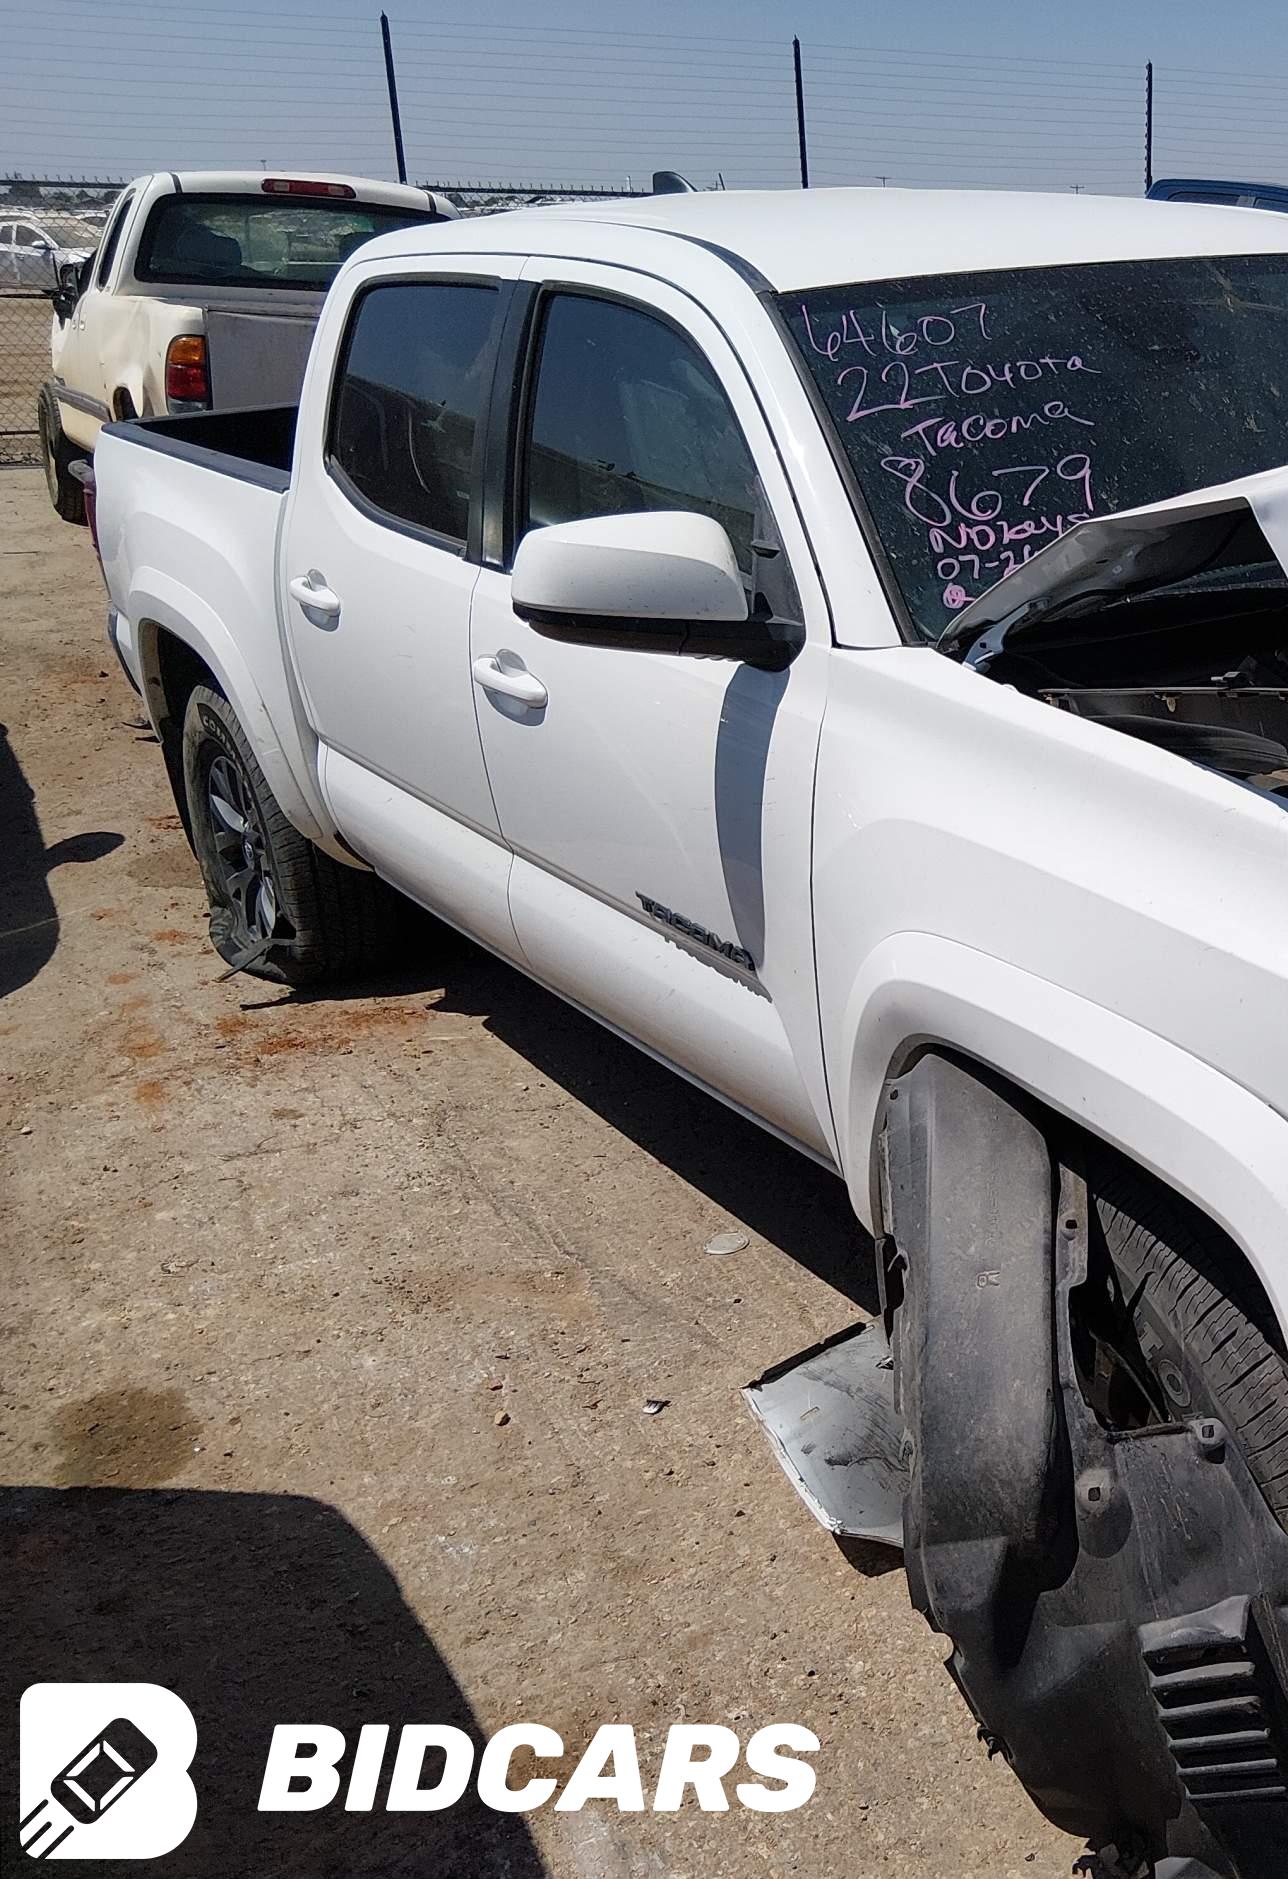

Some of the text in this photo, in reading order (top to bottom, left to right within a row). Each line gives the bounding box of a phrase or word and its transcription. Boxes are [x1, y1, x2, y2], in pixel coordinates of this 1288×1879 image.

[801, 302, 993, 362] 64607
[837, 361, 947, 422] 22
[880, 453, 1095, 527] 8679
